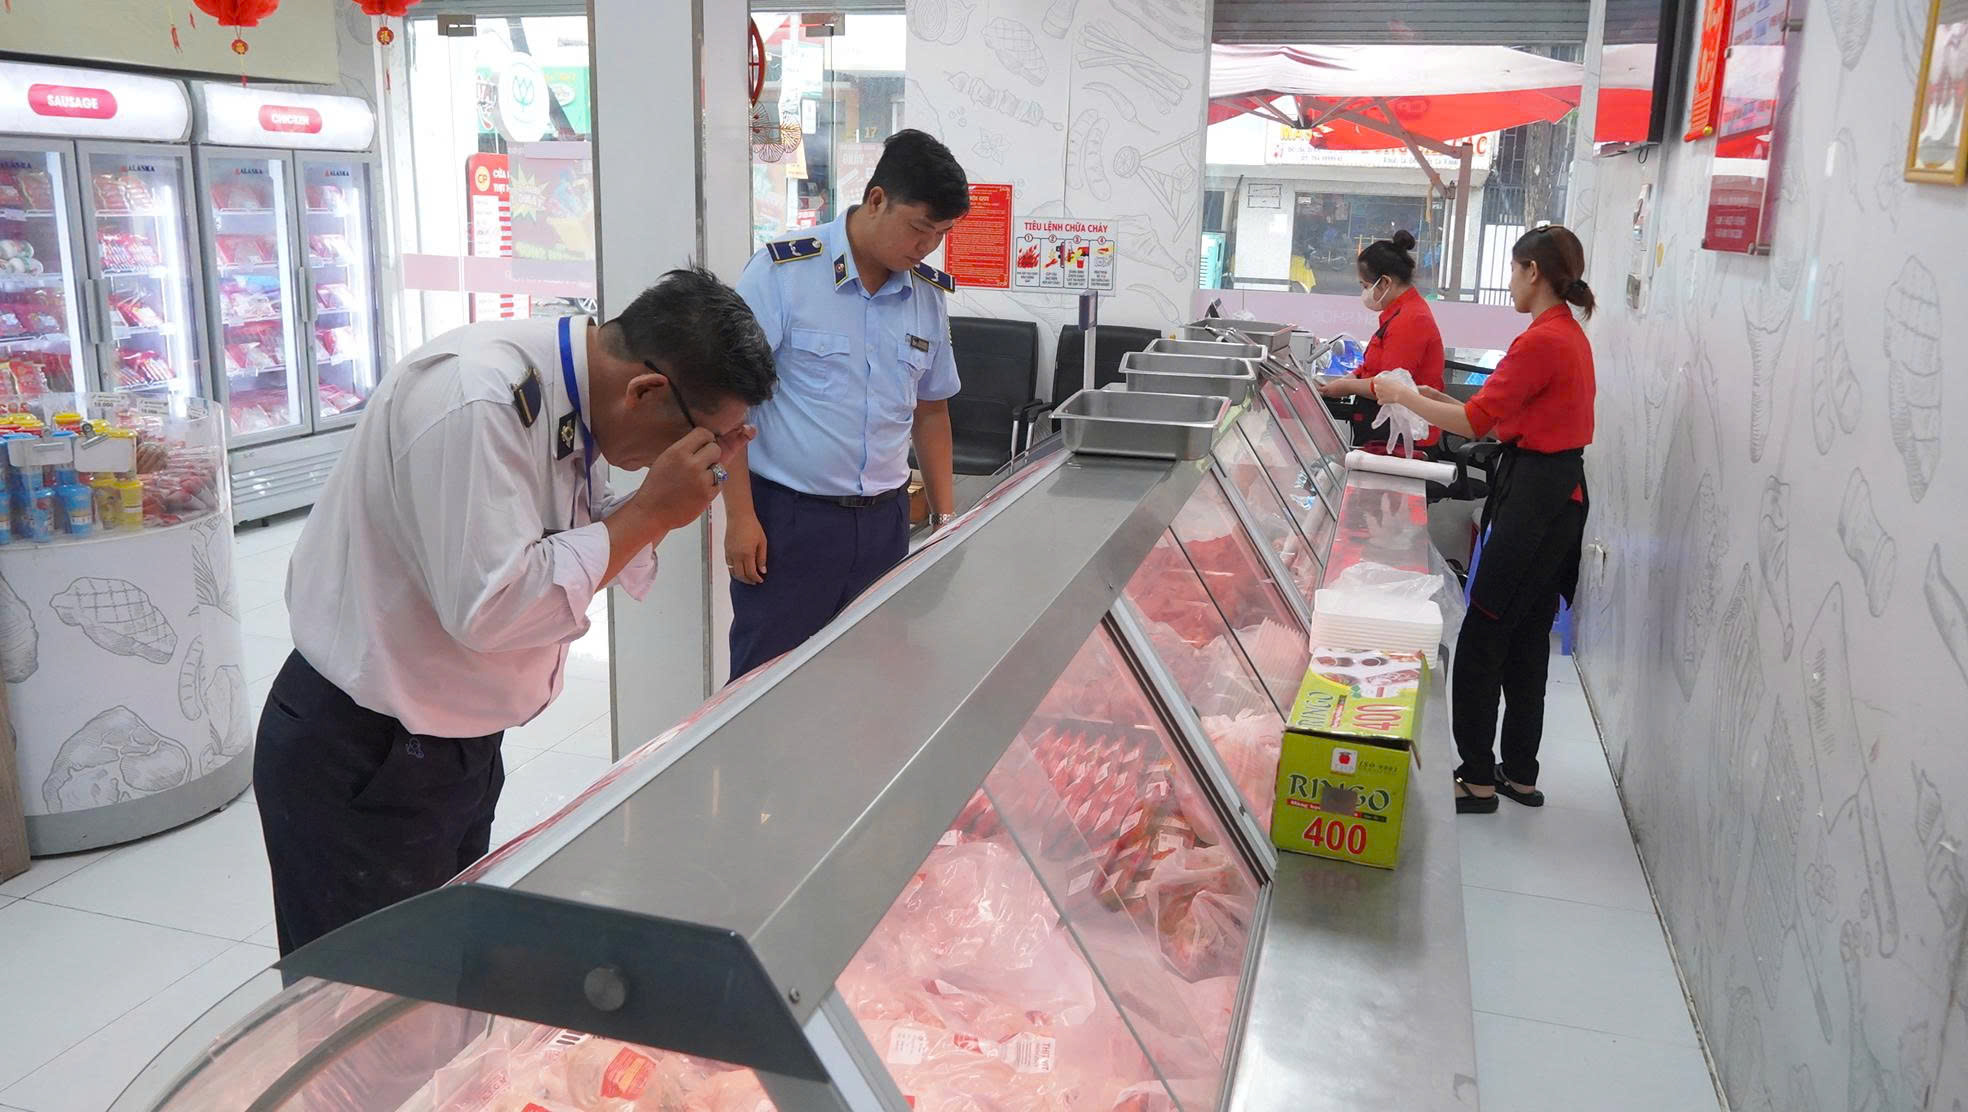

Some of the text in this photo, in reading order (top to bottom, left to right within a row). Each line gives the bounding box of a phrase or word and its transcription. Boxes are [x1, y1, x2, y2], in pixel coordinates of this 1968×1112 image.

[47, 94, 98, 110] SAUSAGE
[271, 113, 310, 126] CHICKEN
[128, 164, 155, 172] ALASKA
[1024, 220, 1108, 233] TIÊU LỆNH CHỮA CHÁY
[1352, 703, 1407, 731] 400
[1303, 816, 1367, 855] 400
